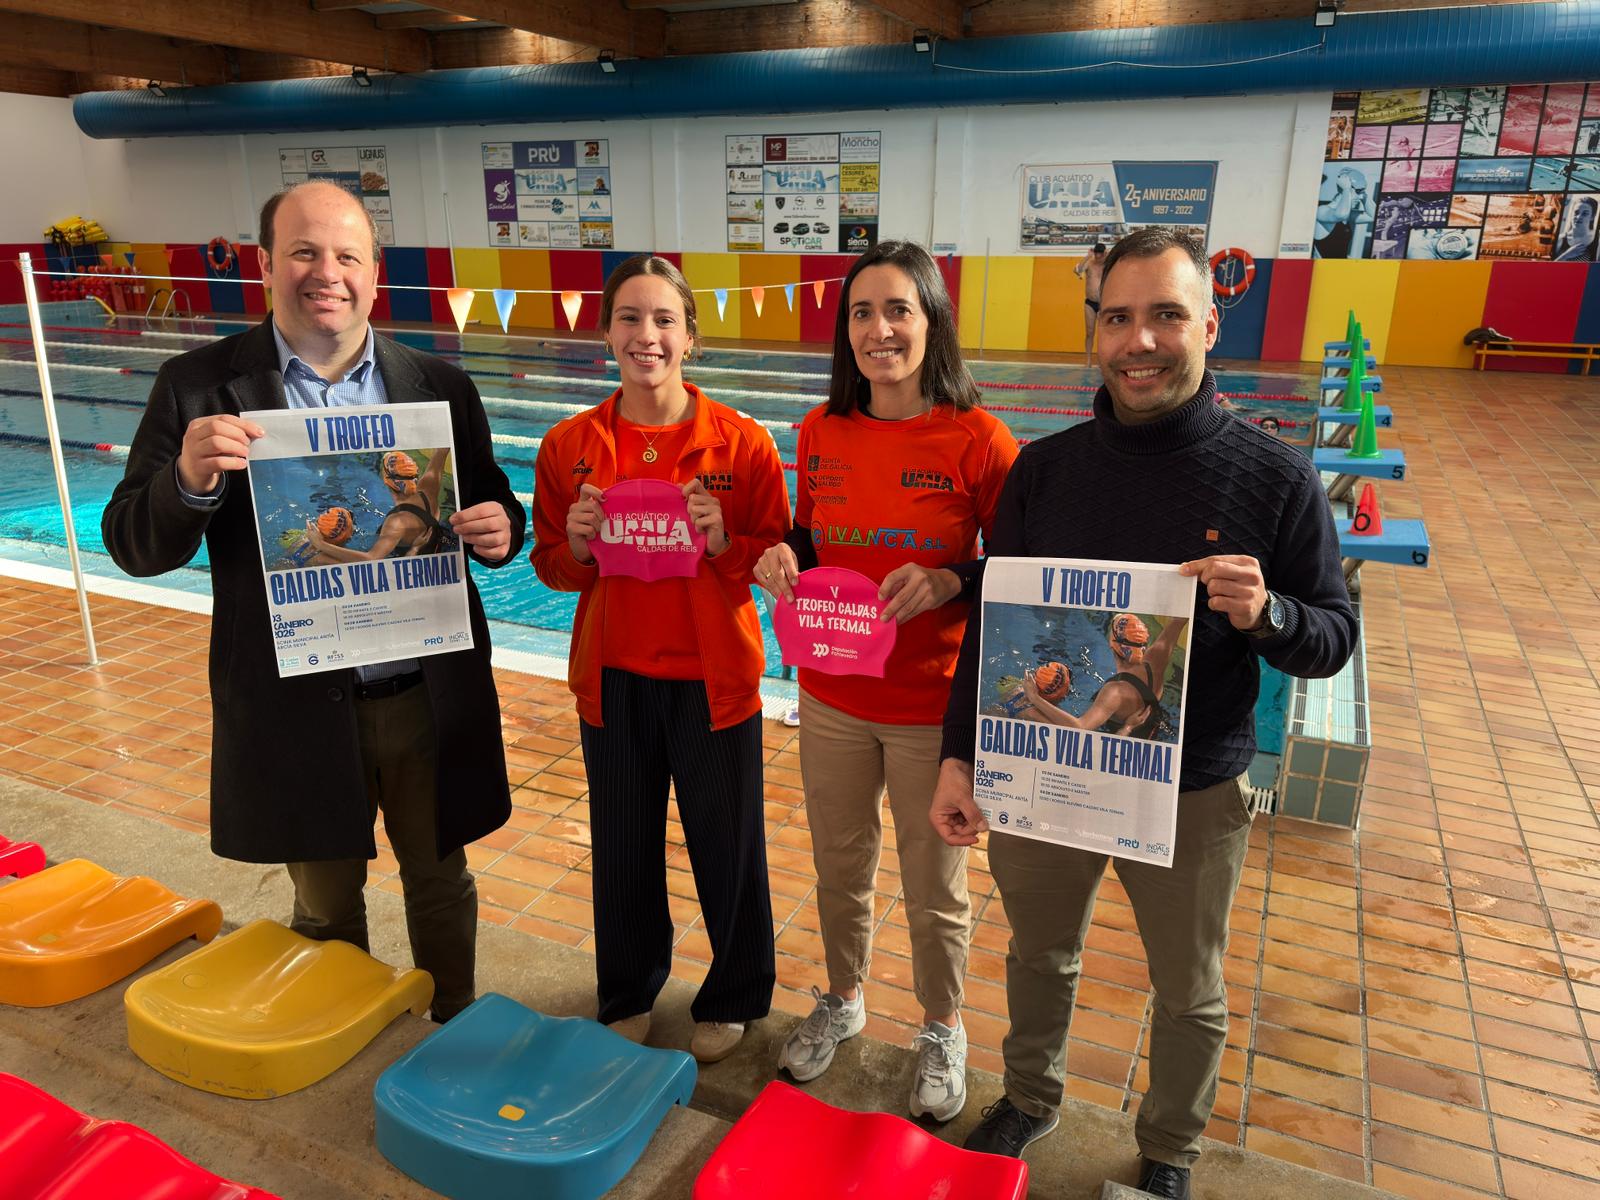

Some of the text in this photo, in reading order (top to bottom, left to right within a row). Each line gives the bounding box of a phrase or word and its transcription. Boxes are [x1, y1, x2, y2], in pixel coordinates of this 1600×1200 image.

[842, 137, 879, 147] Moncho
[1029, 173, 1094, 184] CLUB ACUÁTICO
[1124, 183, 1142, 208] 25
[1142, 188, 1207, 202] ANIVERSARIO
[1063, 209, 1090, 217] CALDAS
[1091, 209, 1100, 217] DE
[1152, 205, 1169, 215] 1997
[1175, 205, 1194, 215] 2022
[847, 238, 869, 247] sierra
[1381, 416, 1392, 427] 4
[304, 413, 396, 452] V TROFEO
[1392, 465, 1403, 479] 5
[610, 511, 670, 521] UB ACUÁTICO
[1354, 505, 1371, 531] 6
[599, 519, 693, 546] UMIA
[637, 545, 667, 554] CALDAS
[668, 545, 679, 553] DE
[269, 554, 461, 606] CALDAS VILA TERMAL
[829, 585, 839, 599] V
[1042, 567, 1132, 609] V TROFEO
[796, 597, 878, 619] TROFEO CALDAS
[798, 614, 872, 636] VILA TERMAL
[980, 718, 1173, 785] CALDAS VILA TERMAL
